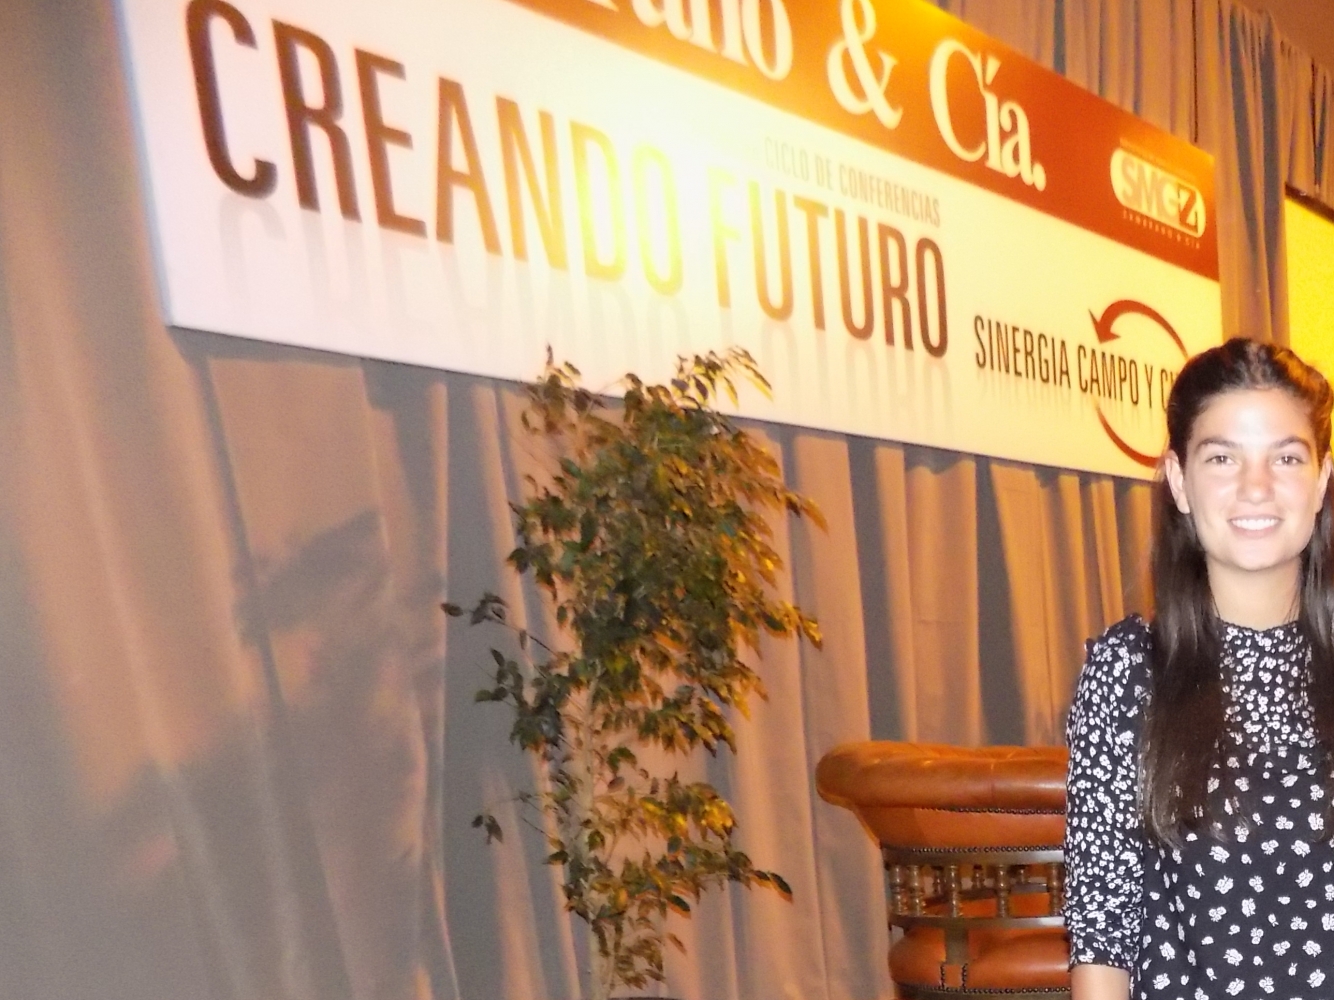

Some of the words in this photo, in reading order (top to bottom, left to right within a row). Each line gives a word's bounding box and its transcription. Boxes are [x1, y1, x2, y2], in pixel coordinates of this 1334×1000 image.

[828, 0, 903, 130] &
[929, 38, 1047, 192] Cía.
[186, 0, 683, 297] CREANDO
[708, 166, 949, 360] FUTURO
[764, 136, 810, 183] CICLO
[815, 153, 834, 191] DE
[839, 162, 941, 229] CONFERENCIAS
[974, 314, 1071, 389] SINERGIA
[1077, 344, 1139, 406] CAMPO
[1144, 363, 1154, 409] Y
